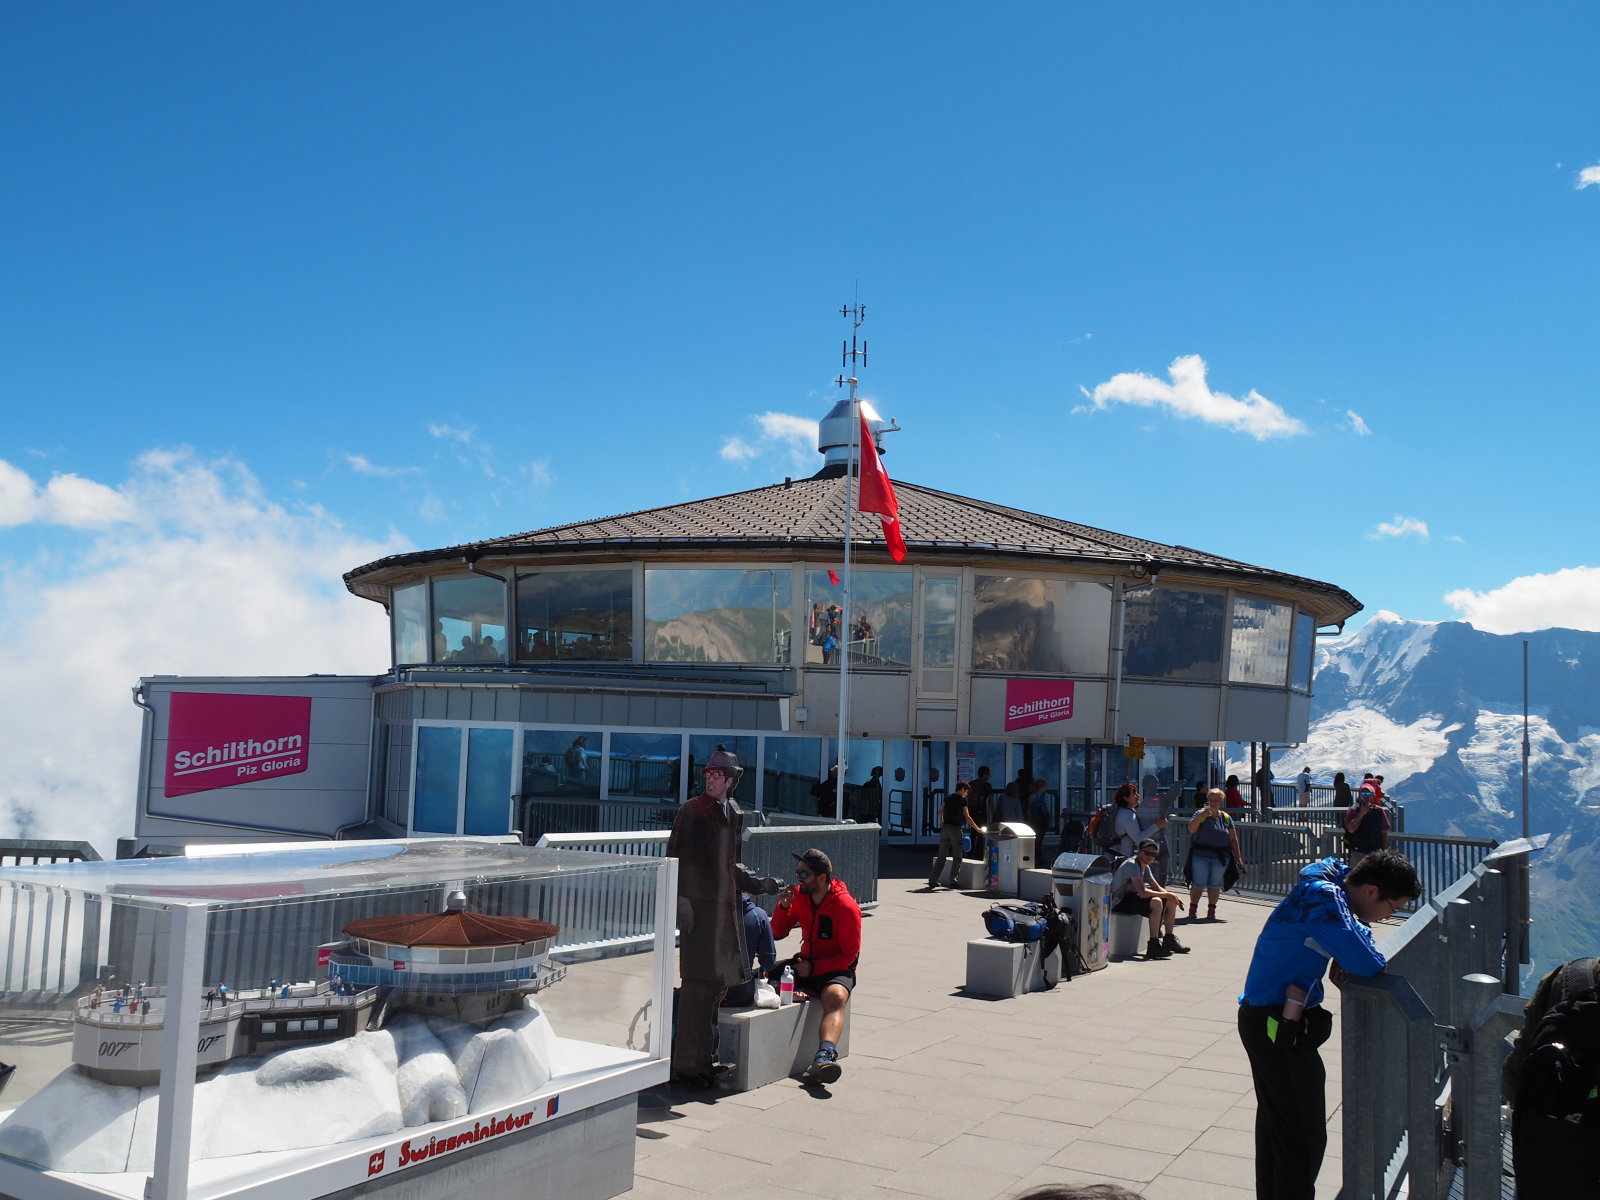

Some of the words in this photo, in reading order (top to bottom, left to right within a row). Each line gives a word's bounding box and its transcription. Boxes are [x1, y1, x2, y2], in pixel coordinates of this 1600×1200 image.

[1008, 696, 1070, 716] Schilthorn
[1050, 709, 1070, 718] Gloria
[173, 734, 302, 770] Schilthorn
[237, 765, 258, 777] Piz
[261, 757, 301, 772] Gloria
[98, 1041, 131, 1056] 007
[197, 1036, 218, 1053] 07
[399, 1112, 534, 1168] Swissminiatur
